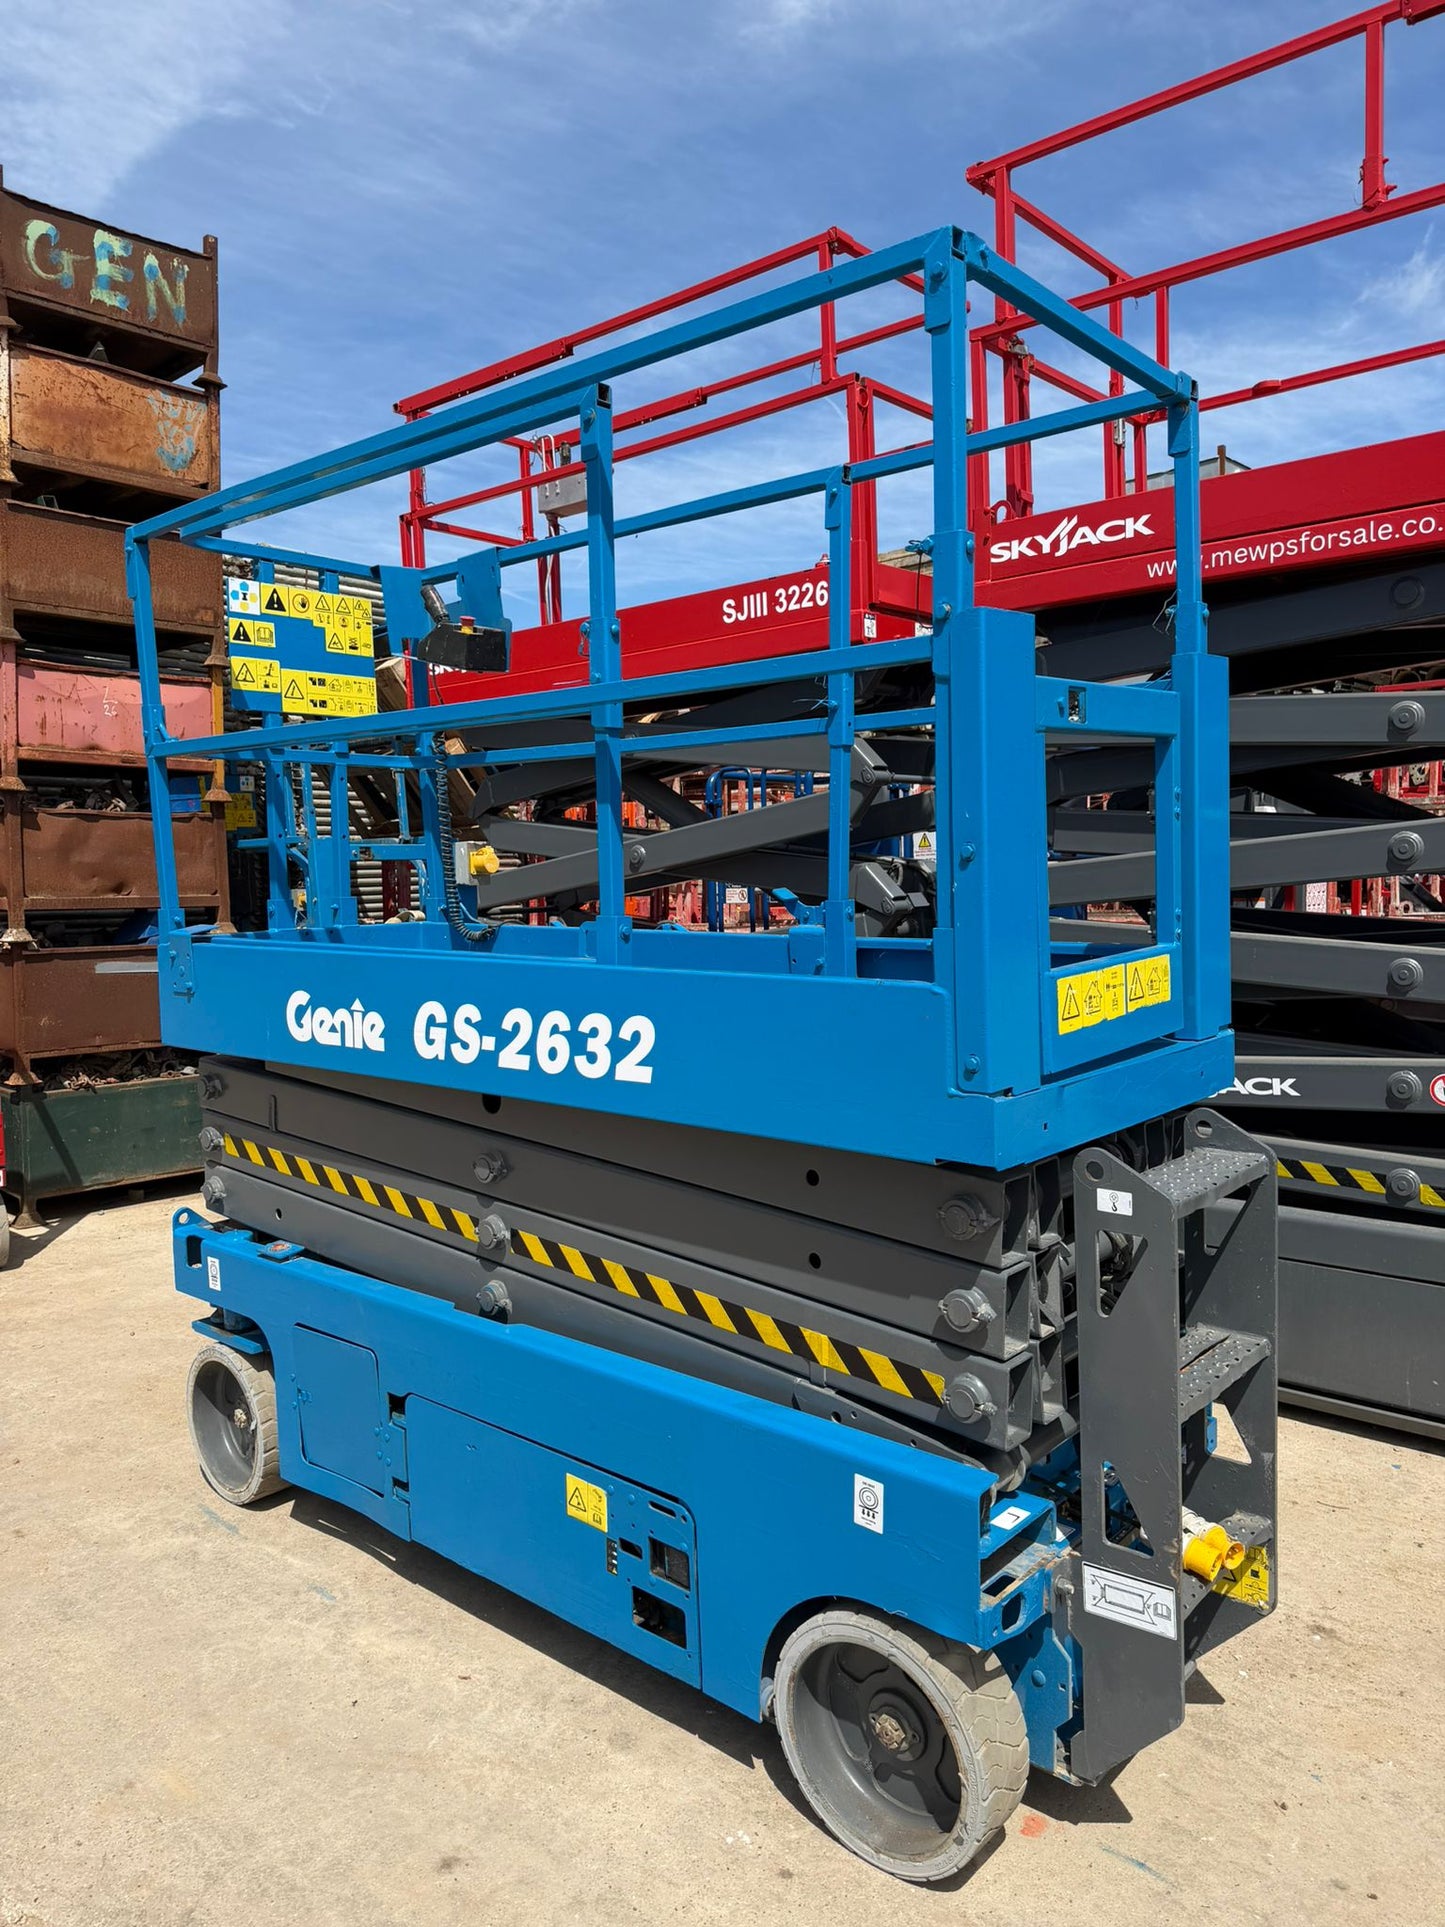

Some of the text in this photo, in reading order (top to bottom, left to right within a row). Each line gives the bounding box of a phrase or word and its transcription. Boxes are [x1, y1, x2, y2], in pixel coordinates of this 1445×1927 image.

[24, 219, 190, 326] GEN
[990, 515, 1156, 563] SKYJACK
[1146, 516, 1444, 579] ww.mewpsforsale.co.
[722, 580, 829, 624] SJIII 3226
[285, 989, 656, 1084] Genie GS-2632
